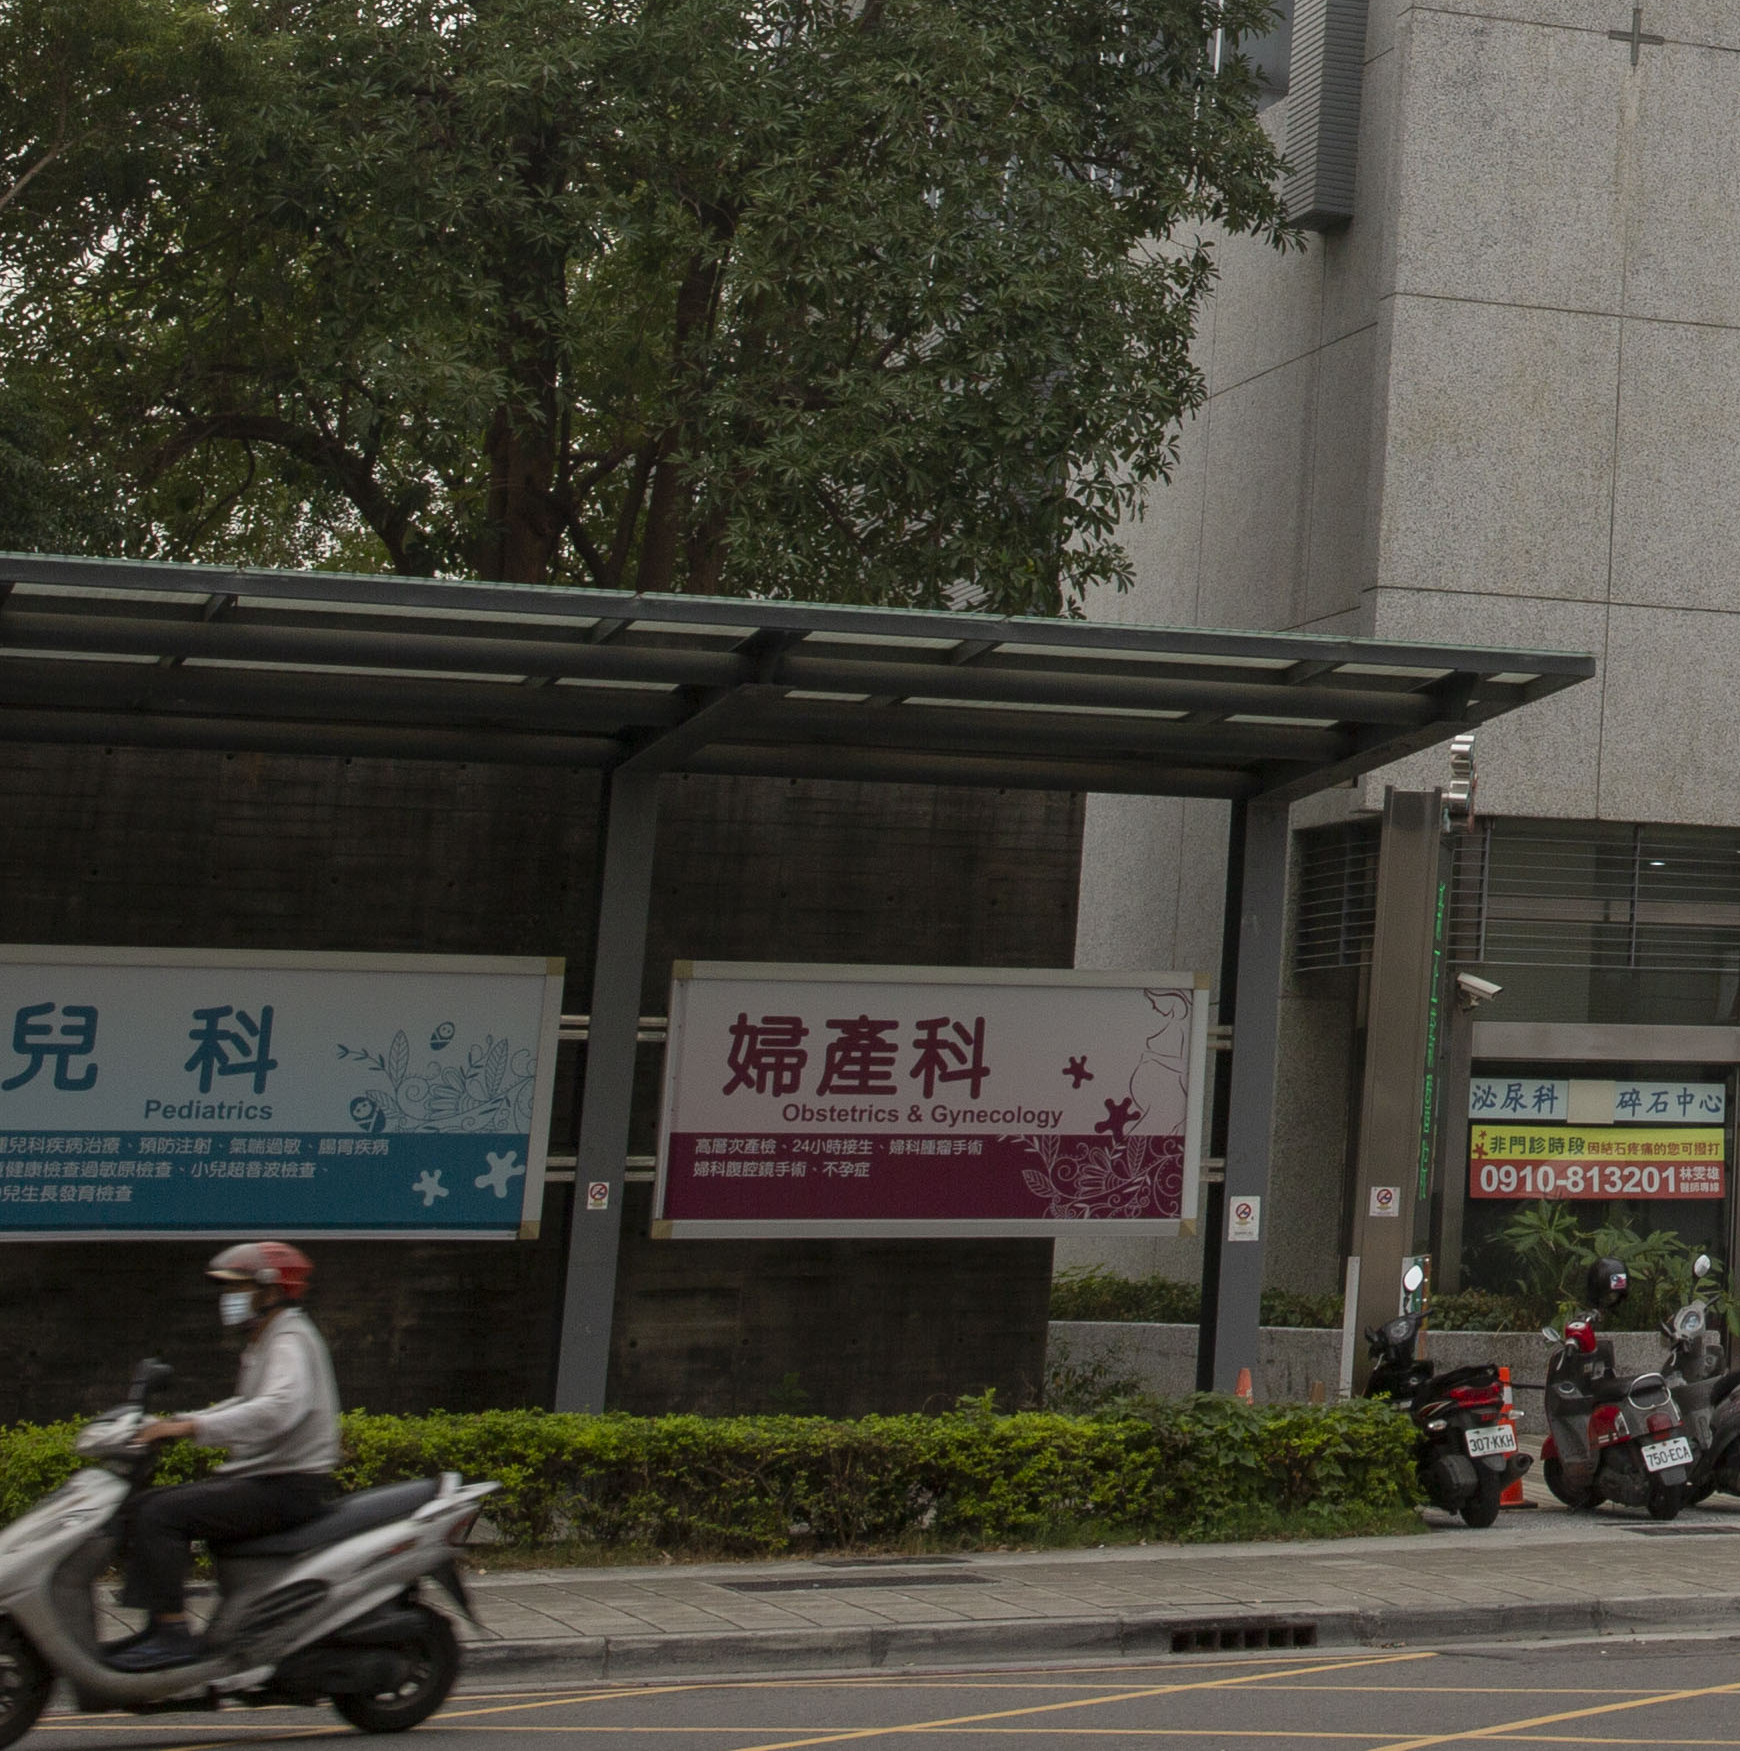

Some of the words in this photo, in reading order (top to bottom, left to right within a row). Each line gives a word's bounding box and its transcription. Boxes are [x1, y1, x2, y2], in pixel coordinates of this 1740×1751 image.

[722, 1012, 990, 1099] 婦產科
[144, 1099, 274, 1121] Pediatrics
[1471, 1082, 1559, 1115] 泌尿科
[1615, 1087, 1723, 1118] 碎石中心
[782, 1103, 899, 1124] Obstetrics
[907, 1104, 923, 1122] &
[931, 1104, 1064, 1128] Gynecology
[1489, 1136, 1586, 1155] 非門診時段
[1479, 1164, 1677, 1194] 0910-813201
[0, 1185, 133, 1203] 兒生長發育檢查
[1469, 1434, 1514, 1453] 307-KKH
[1646, 1445, 1693, 1468] 750-ECA
